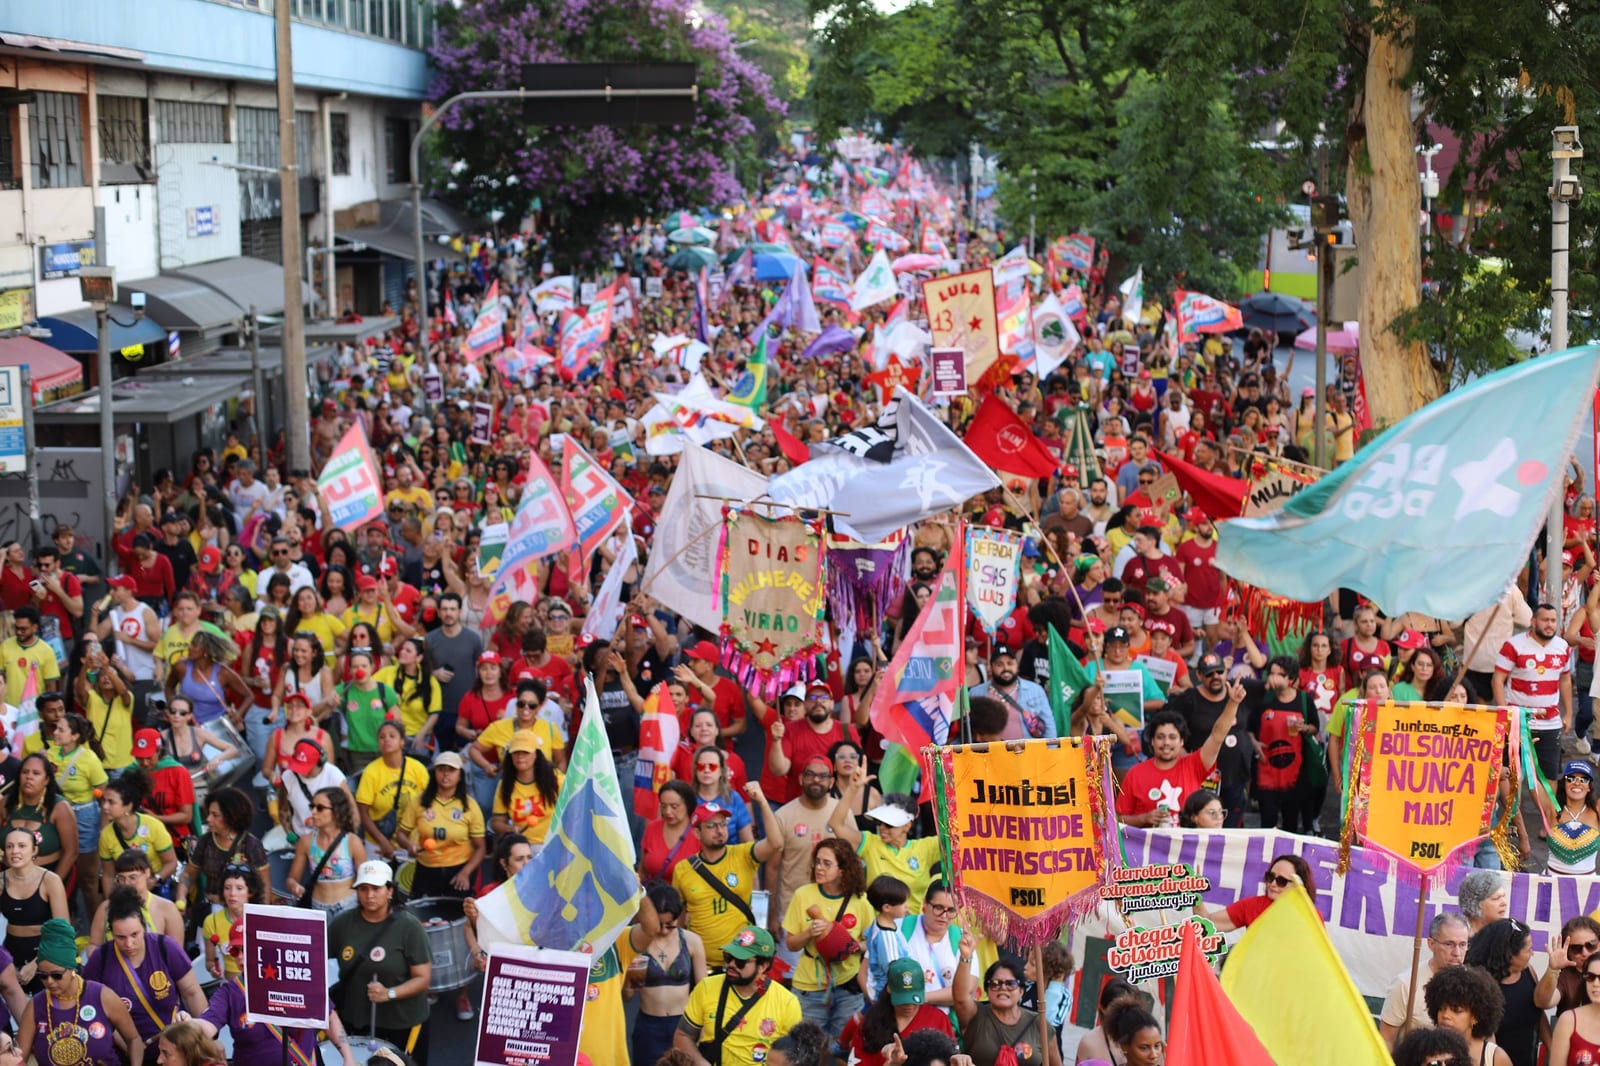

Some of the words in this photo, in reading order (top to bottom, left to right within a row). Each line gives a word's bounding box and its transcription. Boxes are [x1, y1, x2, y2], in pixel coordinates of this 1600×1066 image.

[938, 282, 980, 302] LULA
[932, 309, 953, 332] 13
[1251, 480, 1303, 508] MULH
[748, 539, 809, 563] DIAS
[728, 570, 818, 618] MULHERES
[744, 608, 799, 633] VIRÃO
[1393, 720, 1478, 737] Juntos.org.br
[1380, 732, 1492, 762] BOLSONARO
[1386, 760, 1475, 794] NUNCA
[970, 778, 1076, 806] Juntos!
[1403, 799, 1454, 826] MAIS!
[433, 827, 446, 840] 10
[962, 814, 1083, 841] JUVENTUDE
[1410, 841, 1441, 858] PSOL
[961, 847, 1096, 876] ANTIFASCISTA
[1113, 864, 1170, 881] derrotar
[1173, 865, 1185, 876] a
[1099, 877, 1208, 897] extrema-direita
[713, 896, 728, 915] 10
[1011, 888, 1045, 906] PSOL
[1123, 894, 1195, 911] juntos.org.br
[1119, 927, 1174, 949] chega
[285, 950, 310, 964] 6X1
[285, 966, 312, 981] 5X2
[493, 976, 513, 988] QUE
[514, 980, 575, 996] BOLSONARO
[269, 993, 304, 1004] MULHERES
[490, 996, 523, 1009] VERBA
[525, 1001, 539, 1011] DE
[491, 987, 532, 1001] CORTOU
[533, 993, 558, 1005] 50%
[560, 996, 575, 1006] DA
[488, 1006, 537, 1021] COMBATE
[539, 1012, 553, 1023] AO
[486, 1024, 520, 1037] MAMA
[529, 1021, 543, 1031] DE
[507, 1042, 548, 1053] MULHERES
